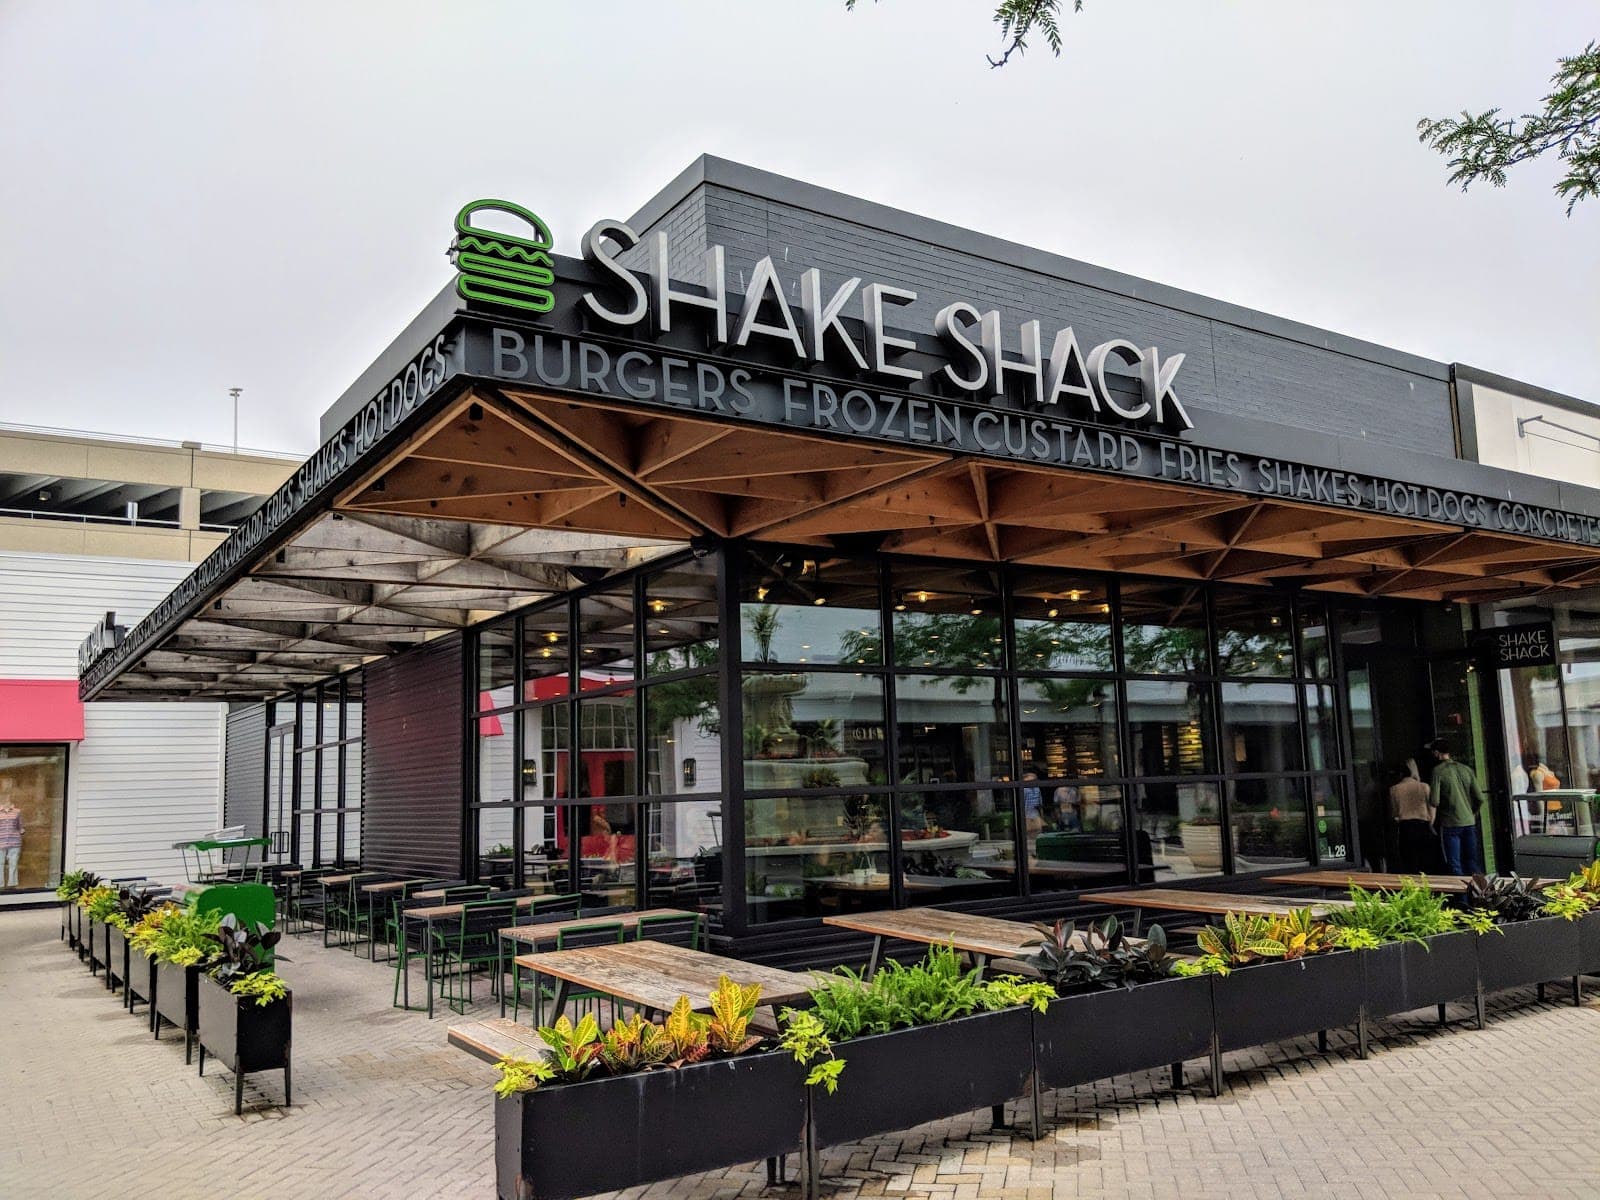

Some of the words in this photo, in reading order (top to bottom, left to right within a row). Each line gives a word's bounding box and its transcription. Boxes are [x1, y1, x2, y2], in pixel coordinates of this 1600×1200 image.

[581, 218, 923, 381] SHAKE
[935, 302, 1194, 429] SHACK
[199, 543, 226, 590] FROZEN
[225, 510, 263, 567] CUSTARD
[266, 479, 293, 534] FRIES
[298, 429, 347, 502] SHAKES
[353, 388, 389, 457] HOT
[391, 334, 446, 426] DOGS
[493, 327, 756, 414] BURGERS
[783, 378, 962, 447] FROZEN
[972, 411, 1143, 472] CUSTARD
[1160, 442, 1242, 488] FRIES
[1258, 459, 1362, 506] SHAKES
[1373, 479, 1422, 515] HOT
[1426, 489, 1487, 525] DOGS
[1498, 630, 1548, 647] SHAKE
[1500, 644, 1550, 661] SHACK
